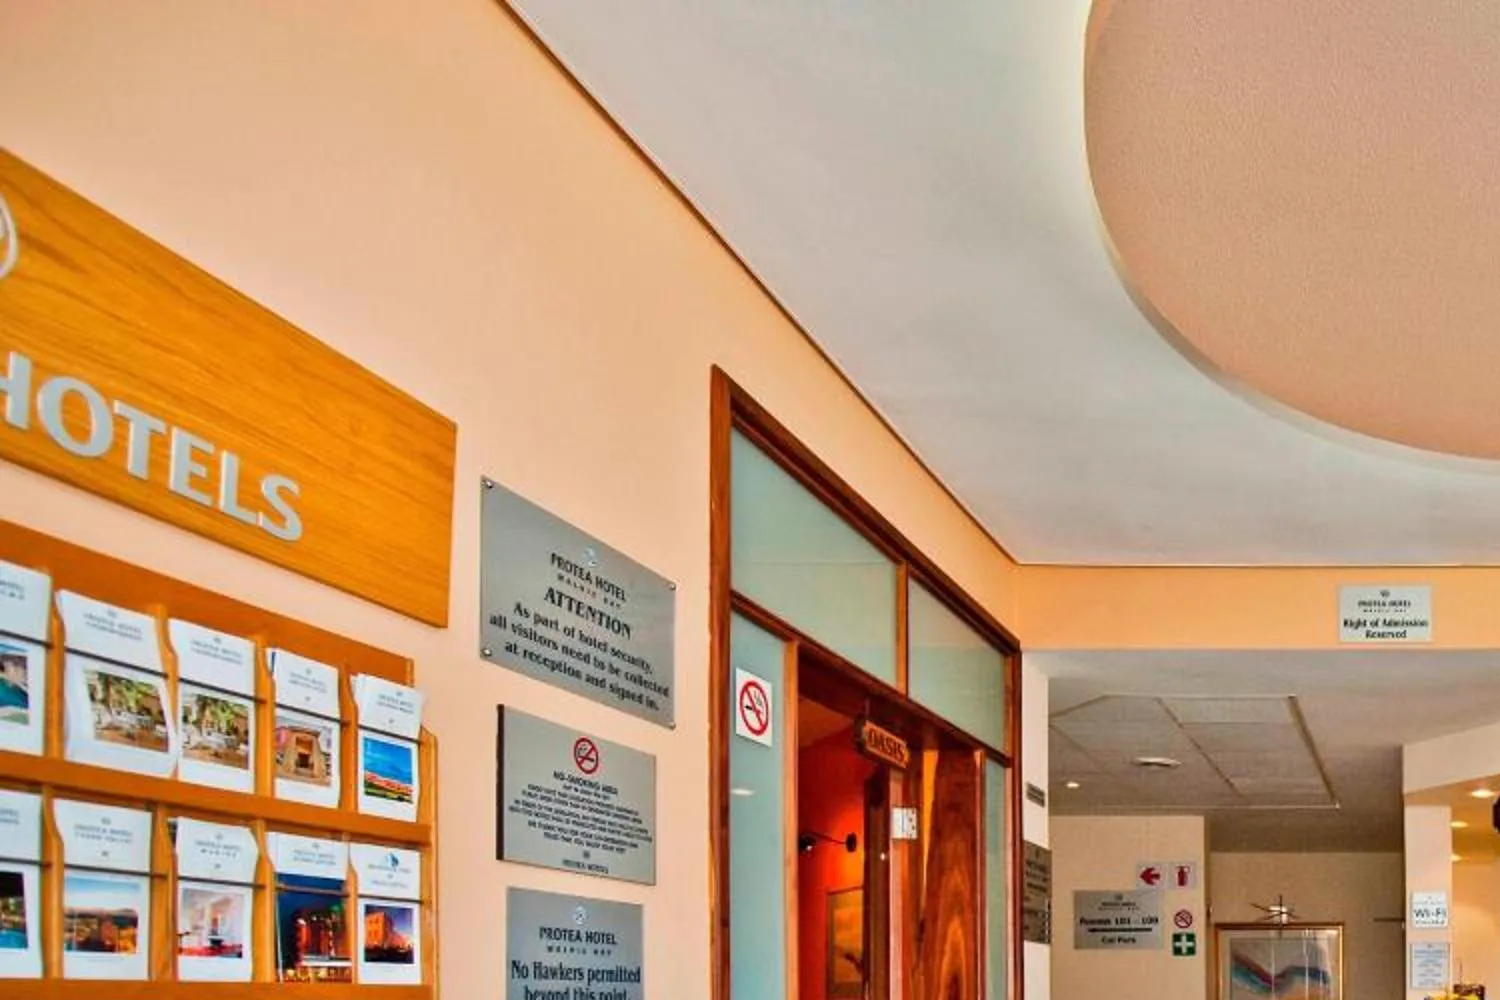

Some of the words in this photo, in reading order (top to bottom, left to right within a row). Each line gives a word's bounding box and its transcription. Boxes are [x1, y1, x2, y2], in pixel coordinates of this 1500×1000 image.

[0, 351, 304, 541] HOTELS
[551, 552, 593, 584] PROTEA
[595, 576, 627, 602] HOTEL
[513, 602, 530, 619] As
[533, 609, 559, 632] part
[563, 622, 576, 639] of
[578, 629, 608, 653] hotel
[544, 586, 632, 640] ATTENTION
[1343, 618, 1367, 630] Right
[1370, 618, 1379, 627] of
[1365, 629, 1407, 639] Reserved
[489, 612, 507, 631] all
[511, 621, 559, 651] visitors
[562, 643, 591, 664] need
[593, 654, 606, 670] to
[608, 661, 622, 676] be
[624, 667, 670, 698] collected
[504, 641, 519, 656] at
[522, 646, 582, 681] reception
[585, 672, 607, 689] and
[609, 682, 644, 706] signed
[539, 926, 583, 943] PROTEA
[585, 931, 618, 946] HOTEL
[511, 959, 529, 981] No
[532, 960, 585, 982] Hawkers
[587, 965, 642, 986] permitted
